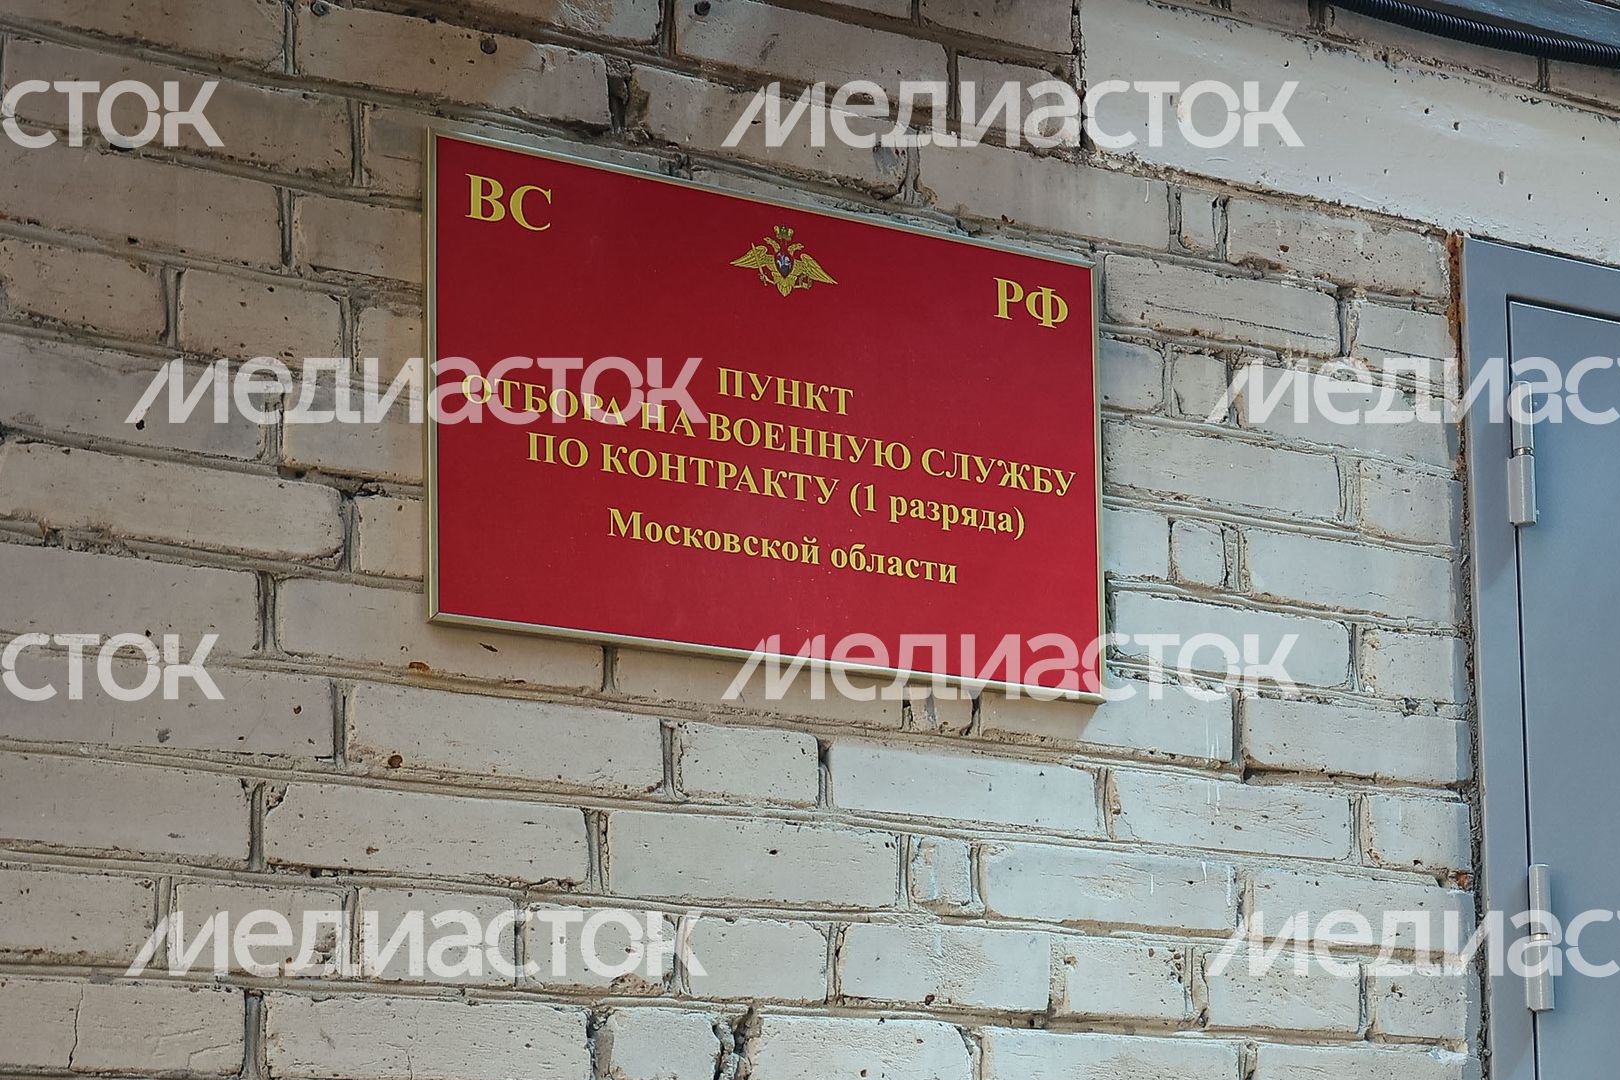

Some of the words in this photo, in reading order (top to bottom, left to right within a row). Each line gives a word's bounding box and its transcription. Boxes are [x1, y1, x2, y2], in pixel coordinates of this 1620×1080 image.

[464, 173, 553, 231] ВС
[993, 276, 1070, 328] РФ
[716, 367, 854, 416] ПУНКТ
[461, 373, 627, 427] ОТБОРА
[640, 400, 695, 438] НА
[707, 412, 912, 471] ВОЕННУЮ
[920, 449, 1077, 497] СЛУЖБУ
[526, 431, 590, 469] ПО
[600, 445, 840, 505] КОНТРАКТУ
[848, 483, 877, 517] (1
[889, 493, 1027, 540] разряда)
[607, 507, 820, 566] Московской
[830, 544, 958, 584] области
